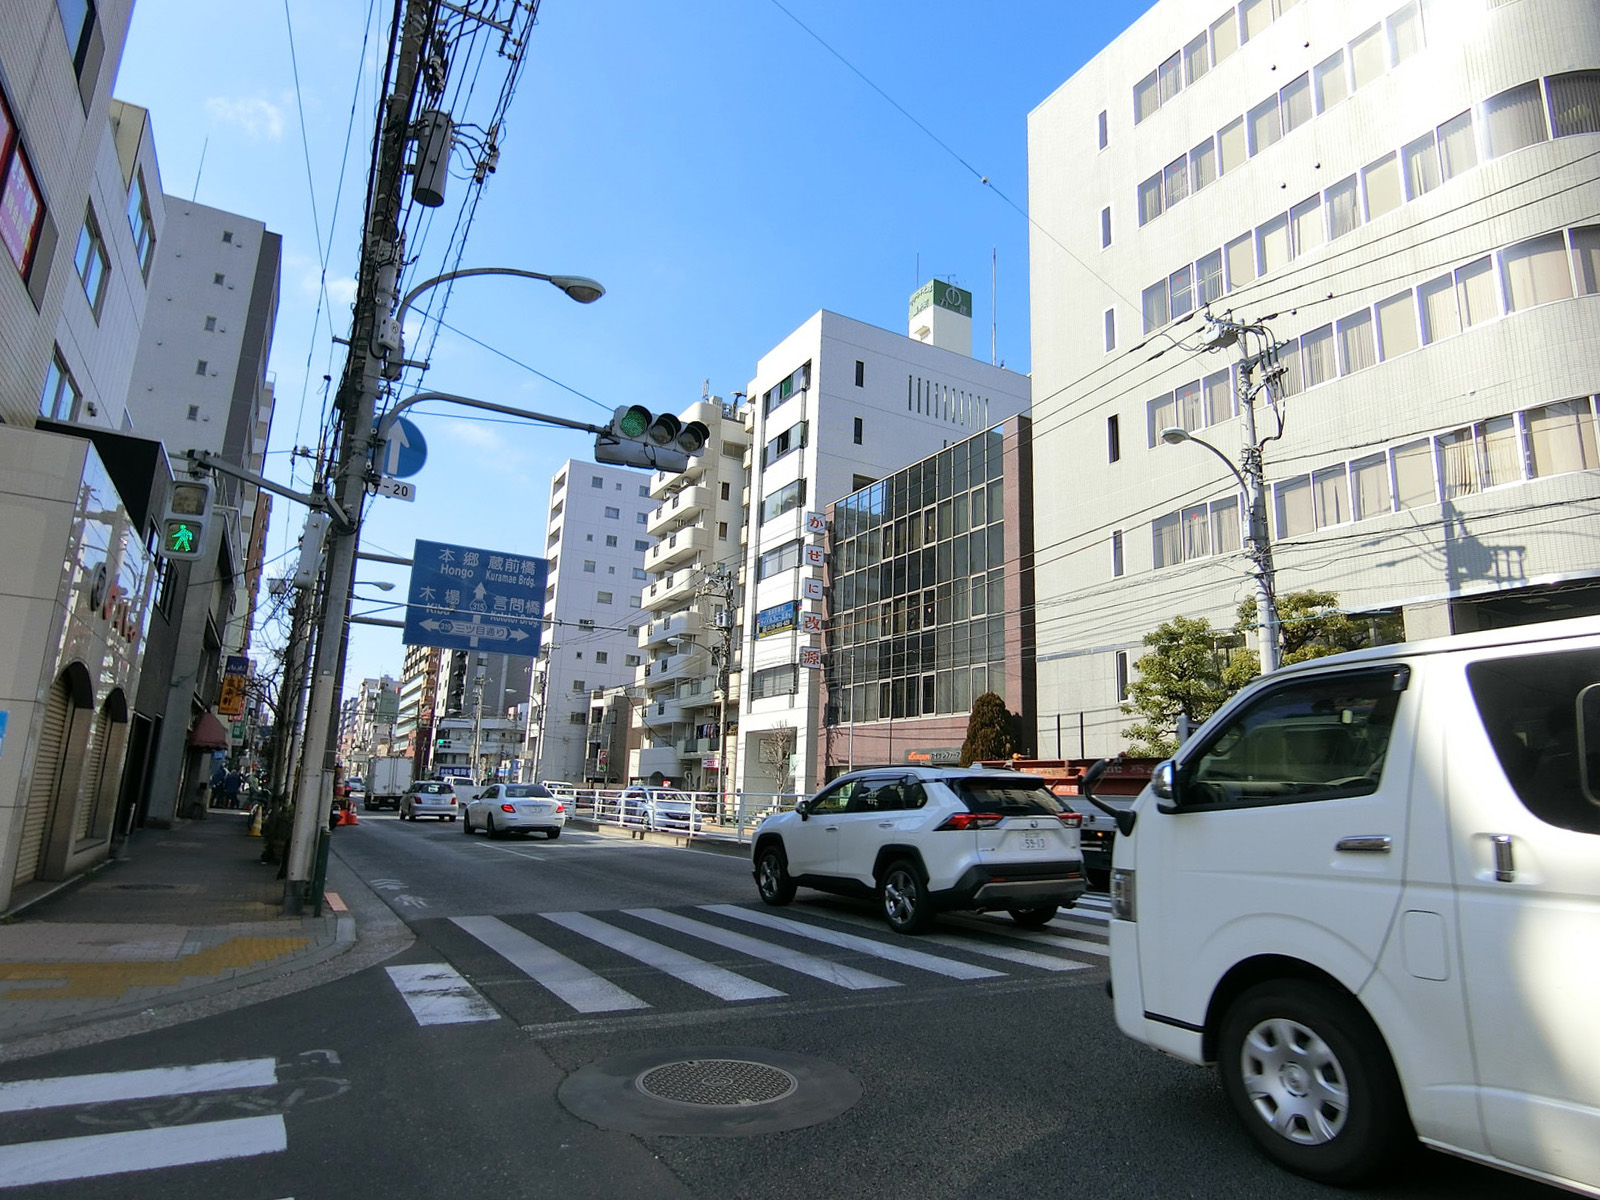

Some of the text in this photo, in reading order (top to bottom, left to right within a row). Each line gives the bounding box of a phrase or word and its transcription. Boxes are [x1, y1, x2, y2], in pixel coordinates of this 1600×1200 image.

[438, 548, 480, 567] 本郷
[488, 555, 536, 576] 蔵前橋
[440, 564, 474, 579] Hongo
[485, 570, 536, 588] Kuramae Brdg.
[419, 586, 460, 605] 木場
[493, 596, 540, 616] 言問橋
[455, 623, 505, 637] 三ツ目通り
